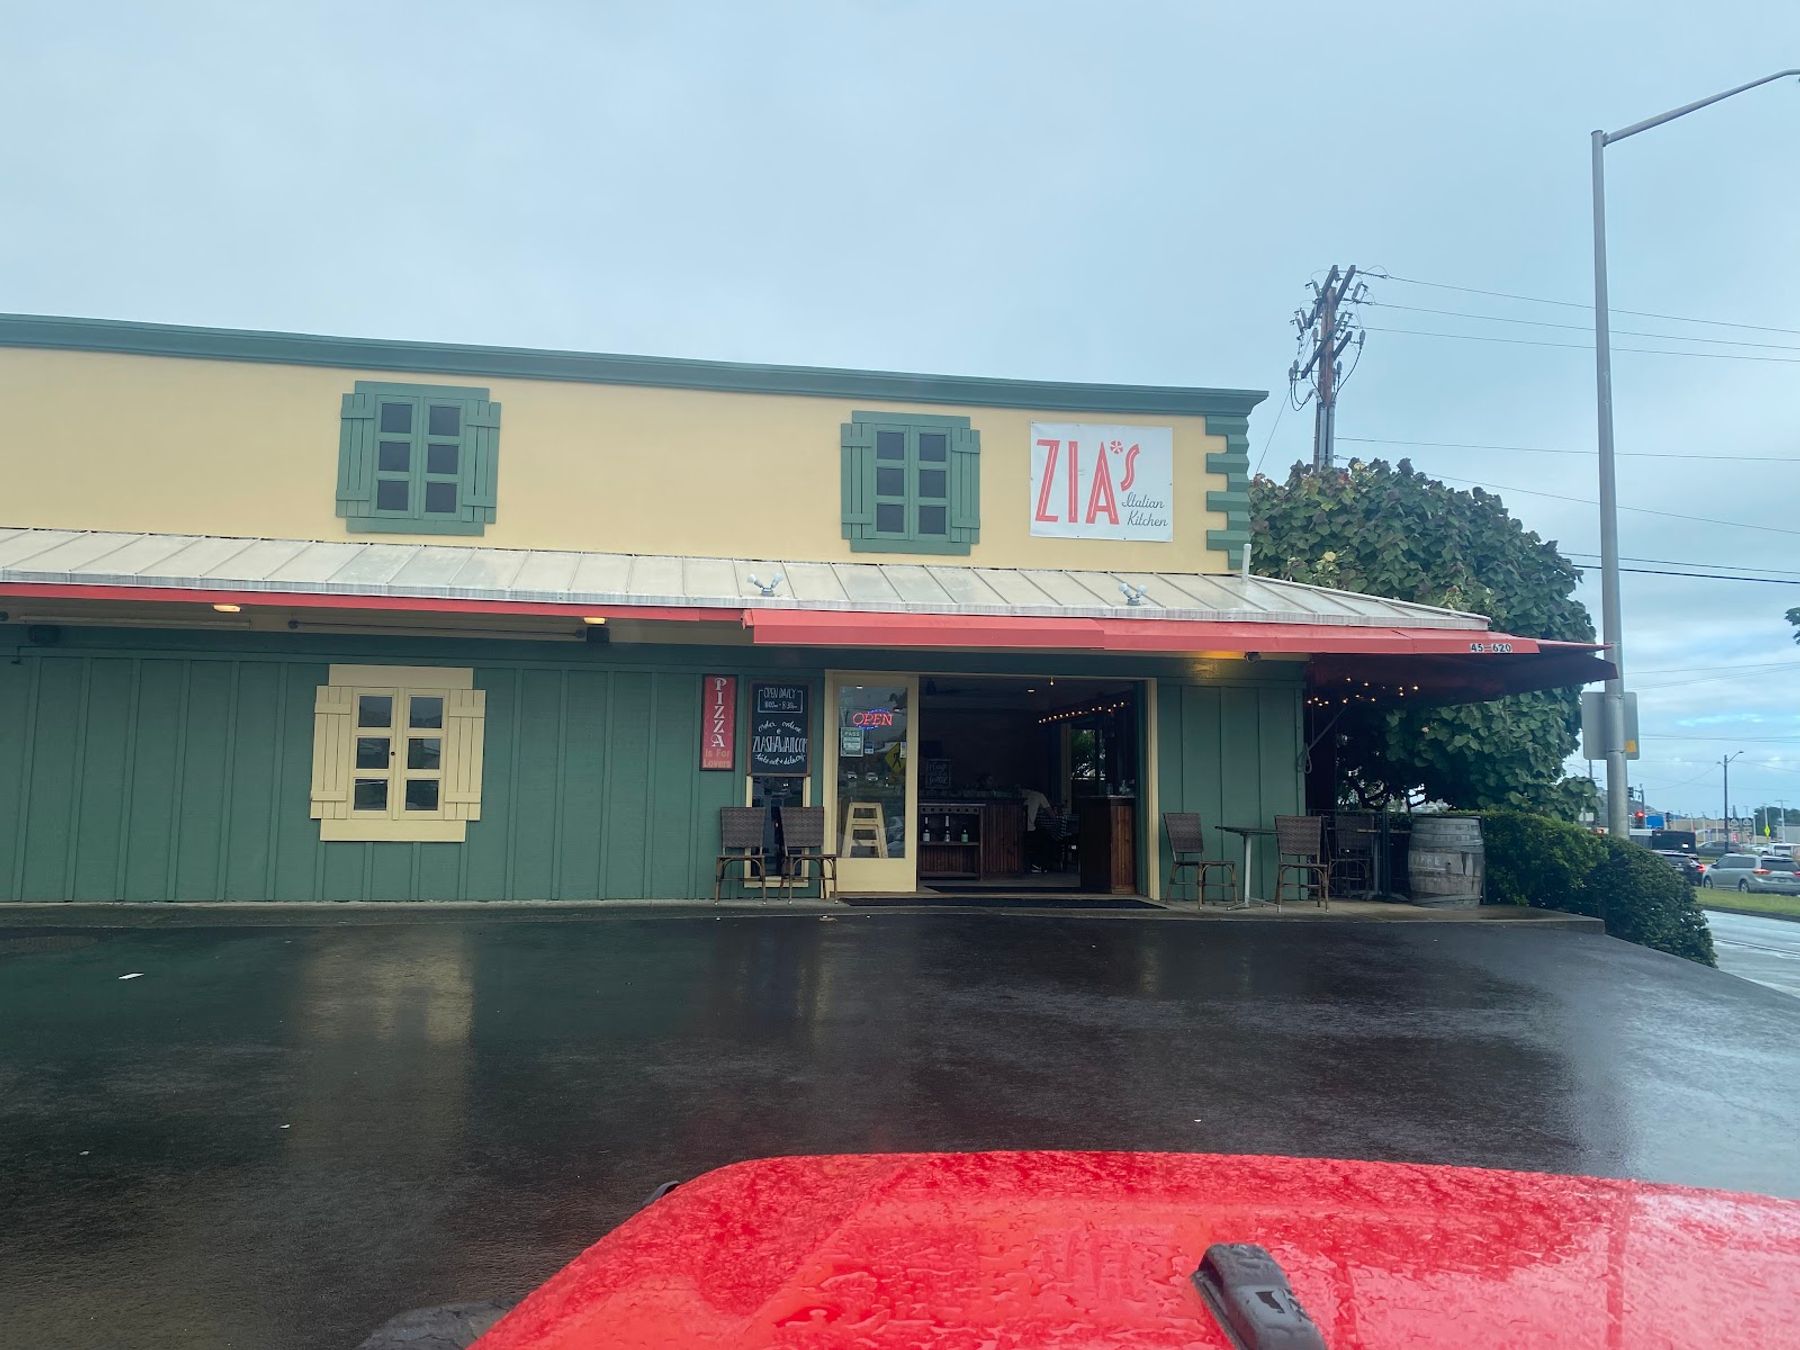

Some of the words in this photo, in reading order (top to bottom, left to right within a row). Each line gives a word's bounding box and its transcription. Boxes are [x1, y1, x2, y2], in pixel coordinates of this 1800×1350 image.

[1121, 492, 1165, 509] Italian
[1127, 511, 1168, 527] Kitchen
[1470, 643, 1512, 653] 45-620
[764, 687, 778, 699] OPEN
[711, 677, 727, 748] PIZZA
[852, 712, 893, 726] OPEN
